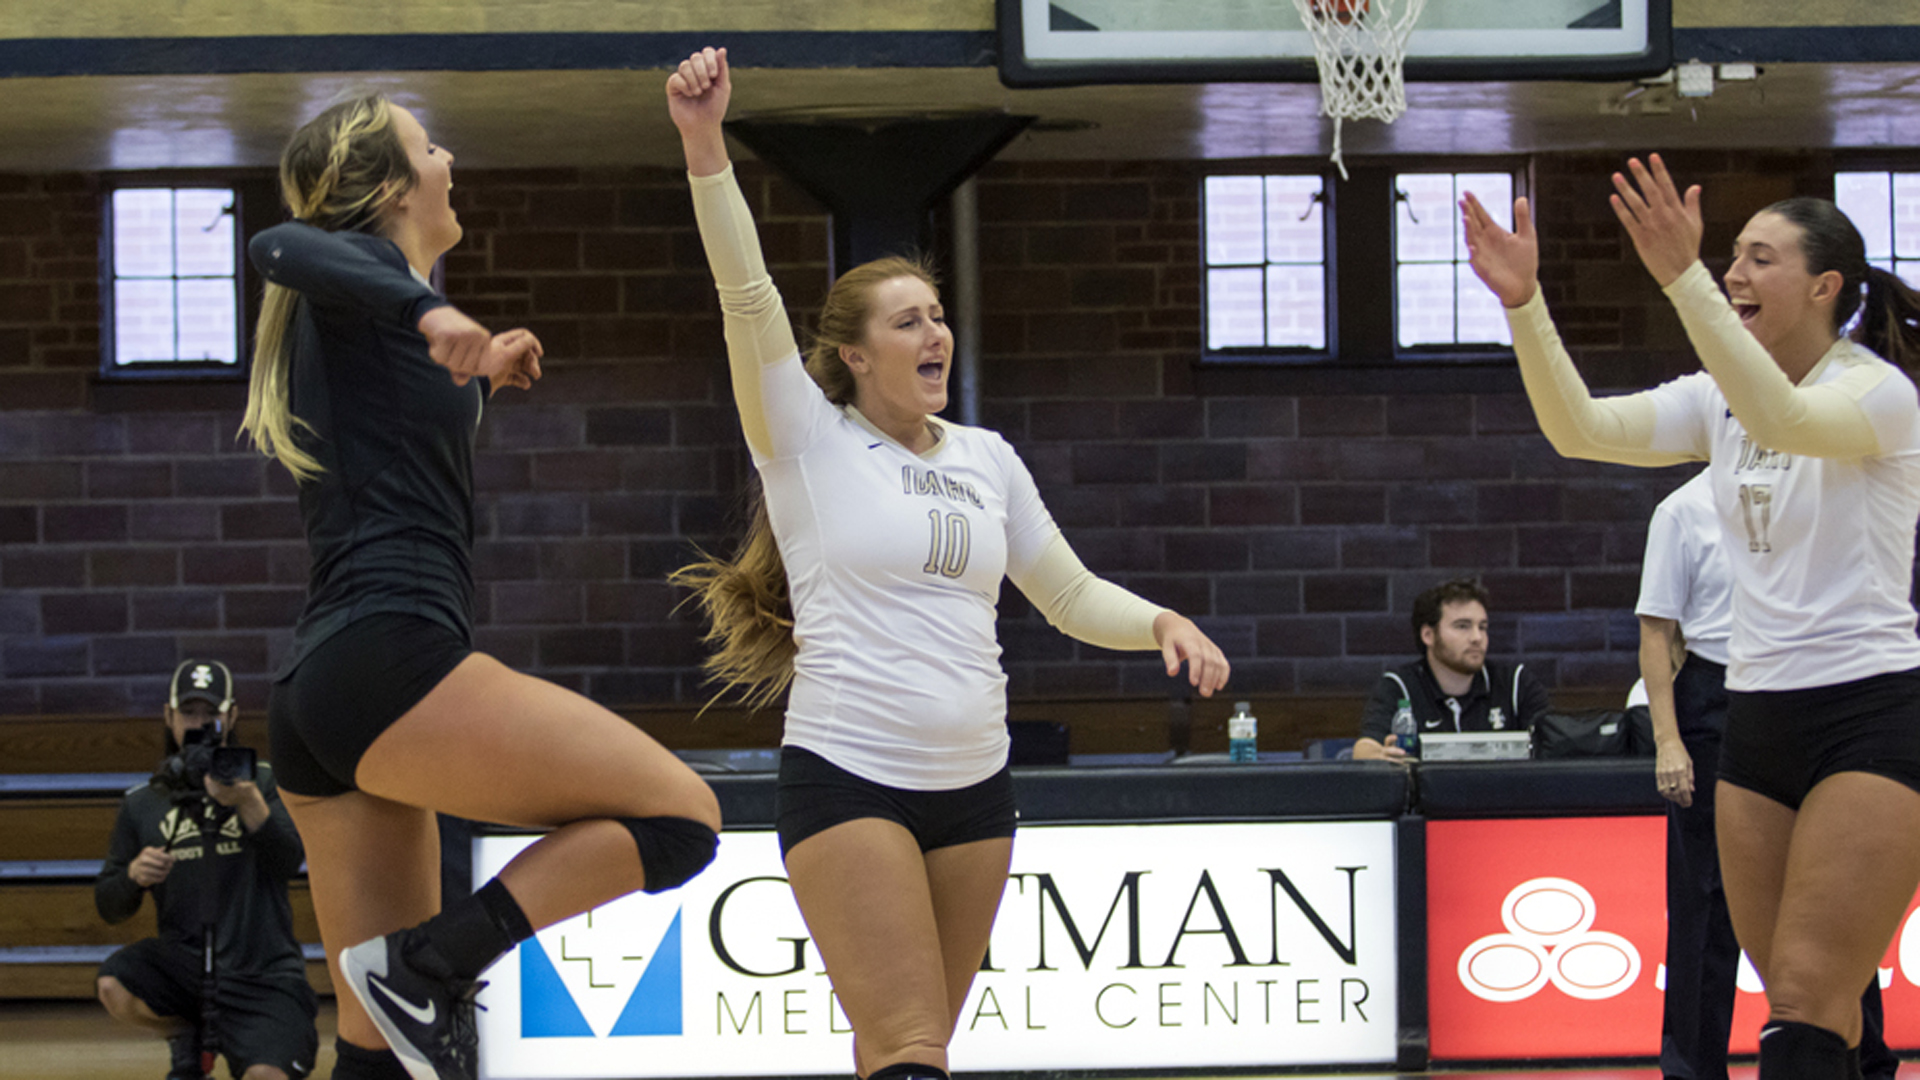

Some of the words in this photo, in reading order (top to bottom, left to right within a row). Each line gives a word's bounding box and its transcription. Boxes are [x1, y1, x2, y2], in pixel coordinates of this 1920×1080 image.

[923, 509, 971, 579] 10
[1739, 483, 1772, 553] 17
[169, 842, 242, 861] FOOTALL
[708, 866, 1368, 979] GMAN
[716, 985, 1047, 1035] MEAL
[1095, 977, 1370, 1029] CENTER
